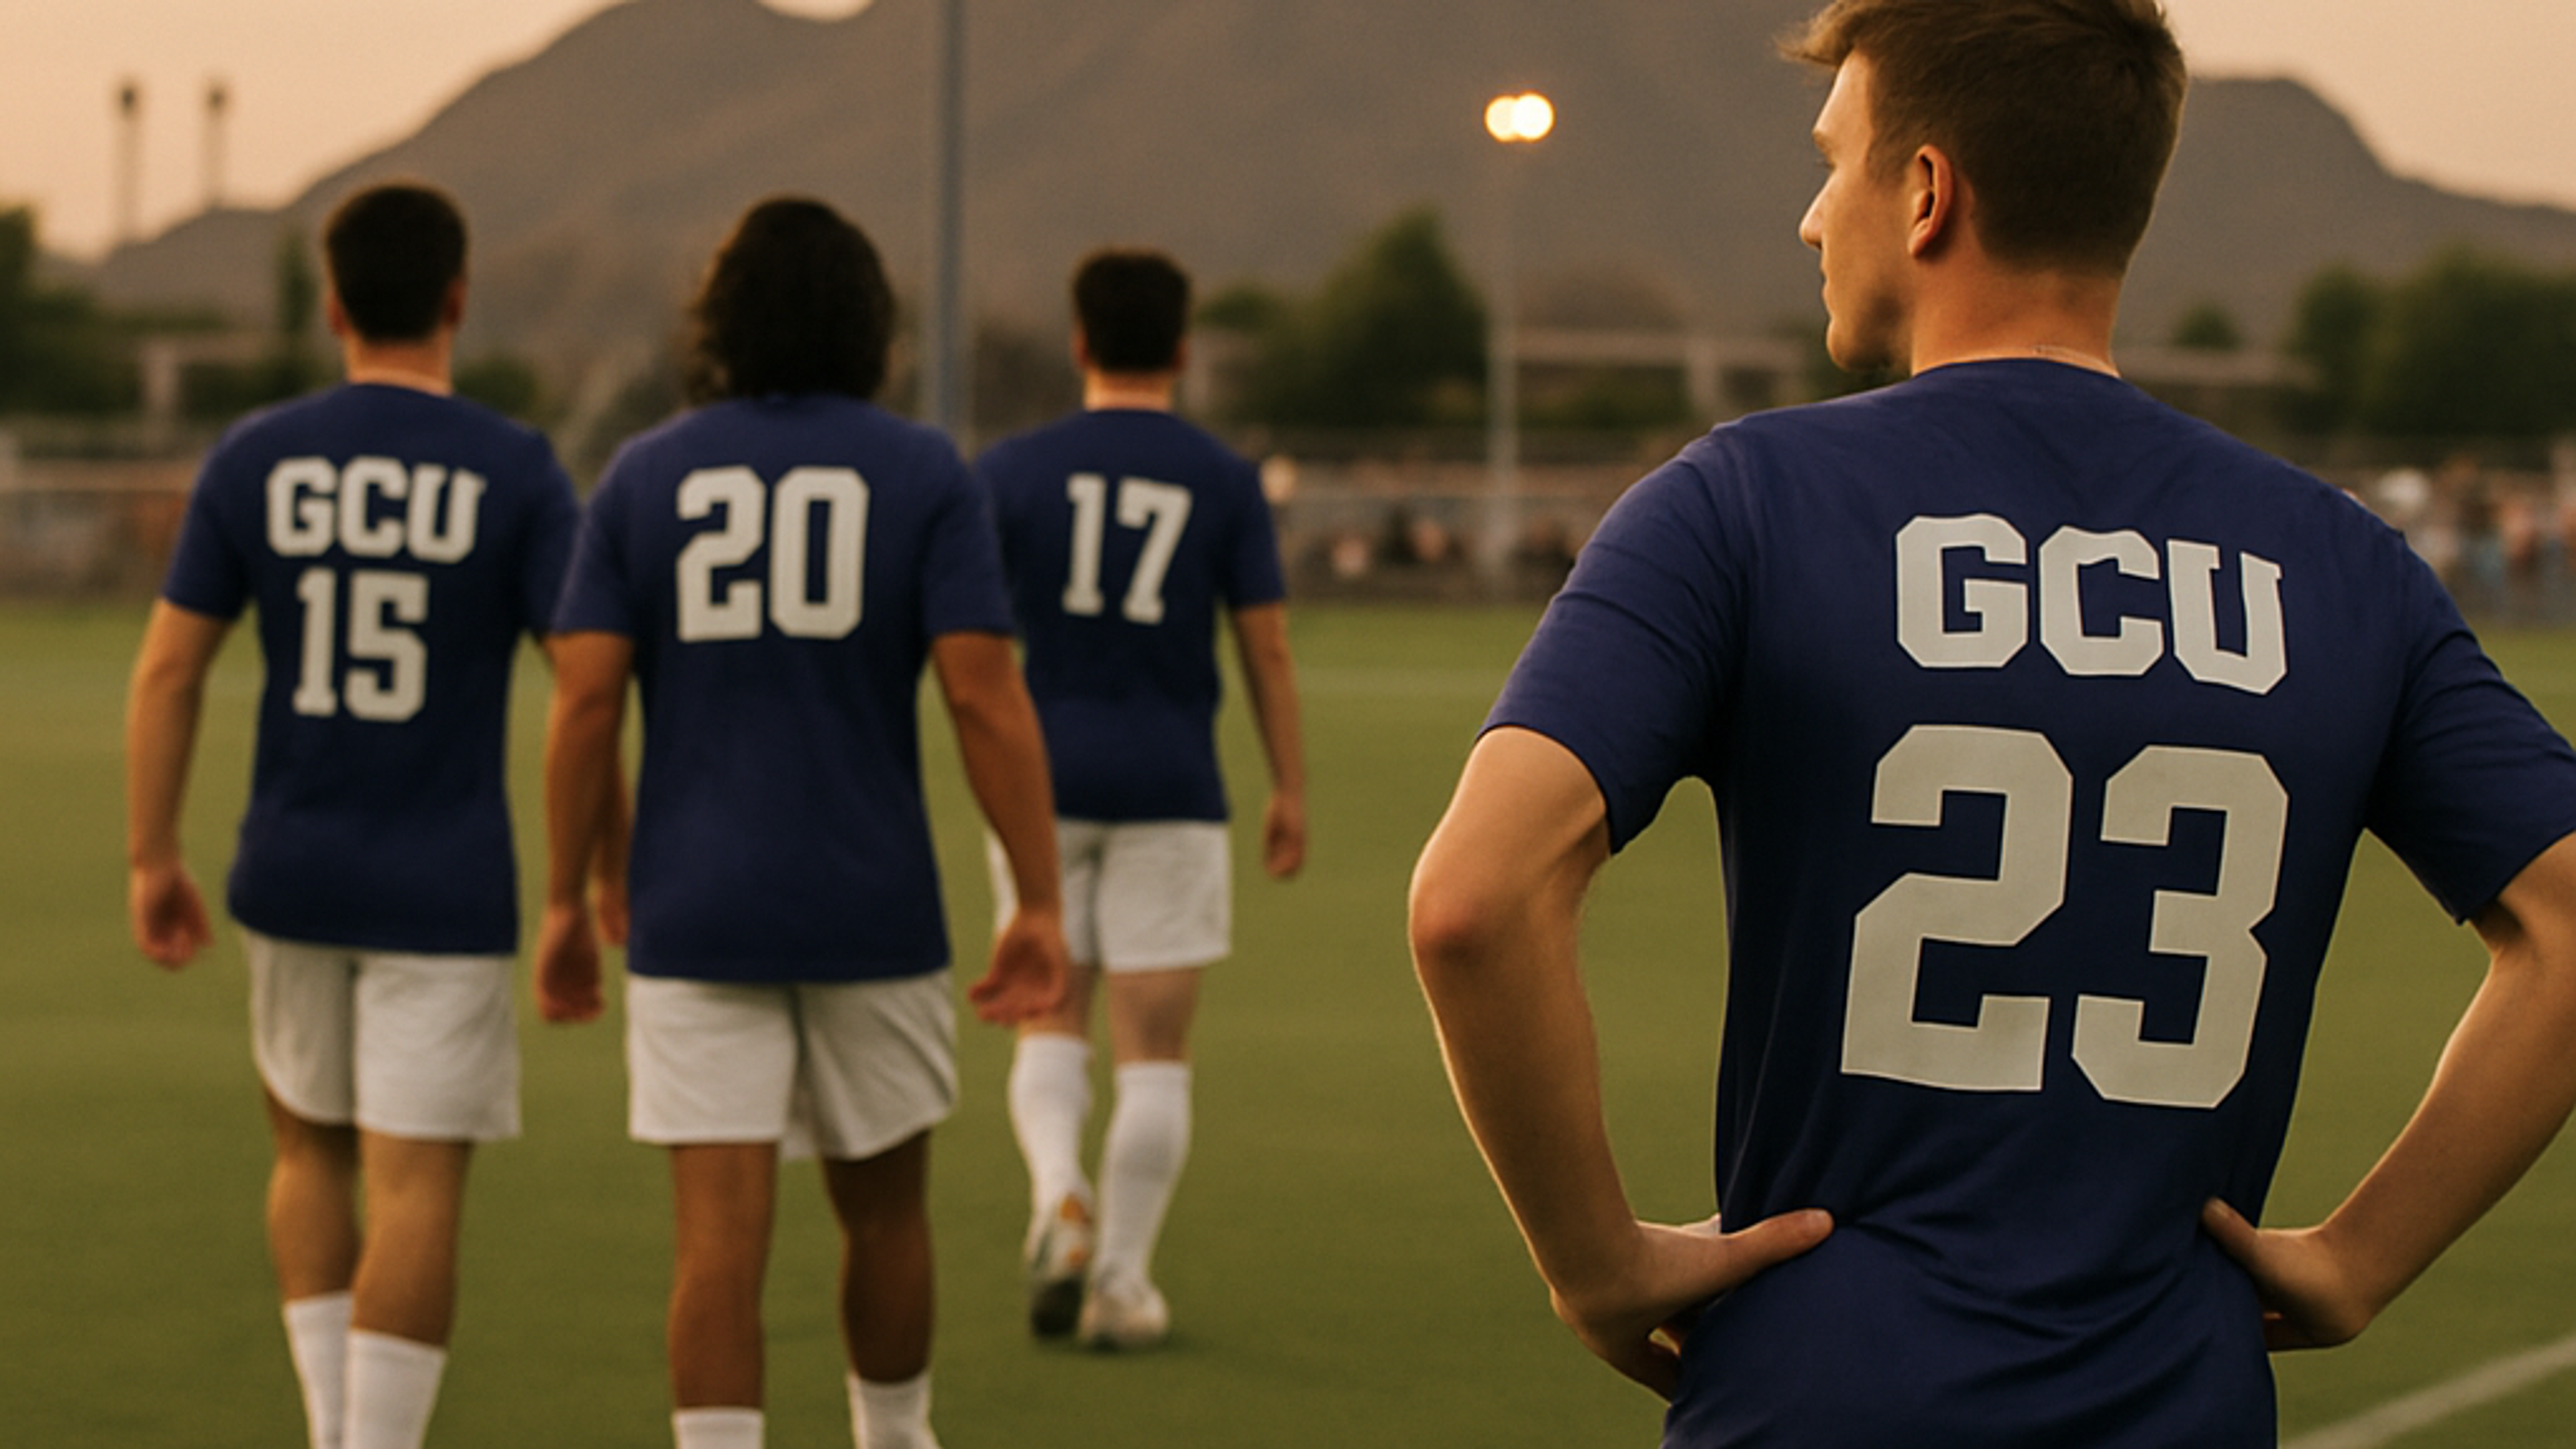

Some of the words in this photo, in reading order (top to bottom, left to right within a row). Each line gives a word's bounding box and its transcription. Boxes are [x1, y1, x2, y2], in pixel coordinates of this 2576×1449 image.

[266, 455, 486, 564] GCU
[676, 465, 869, 642] 20
[1065, 472, 1192, 623] 17
[292, 568, 429, 722] 15
[1894, 512, 2288, 697] GCU
[1839, 724, 2290, 1110] 23
